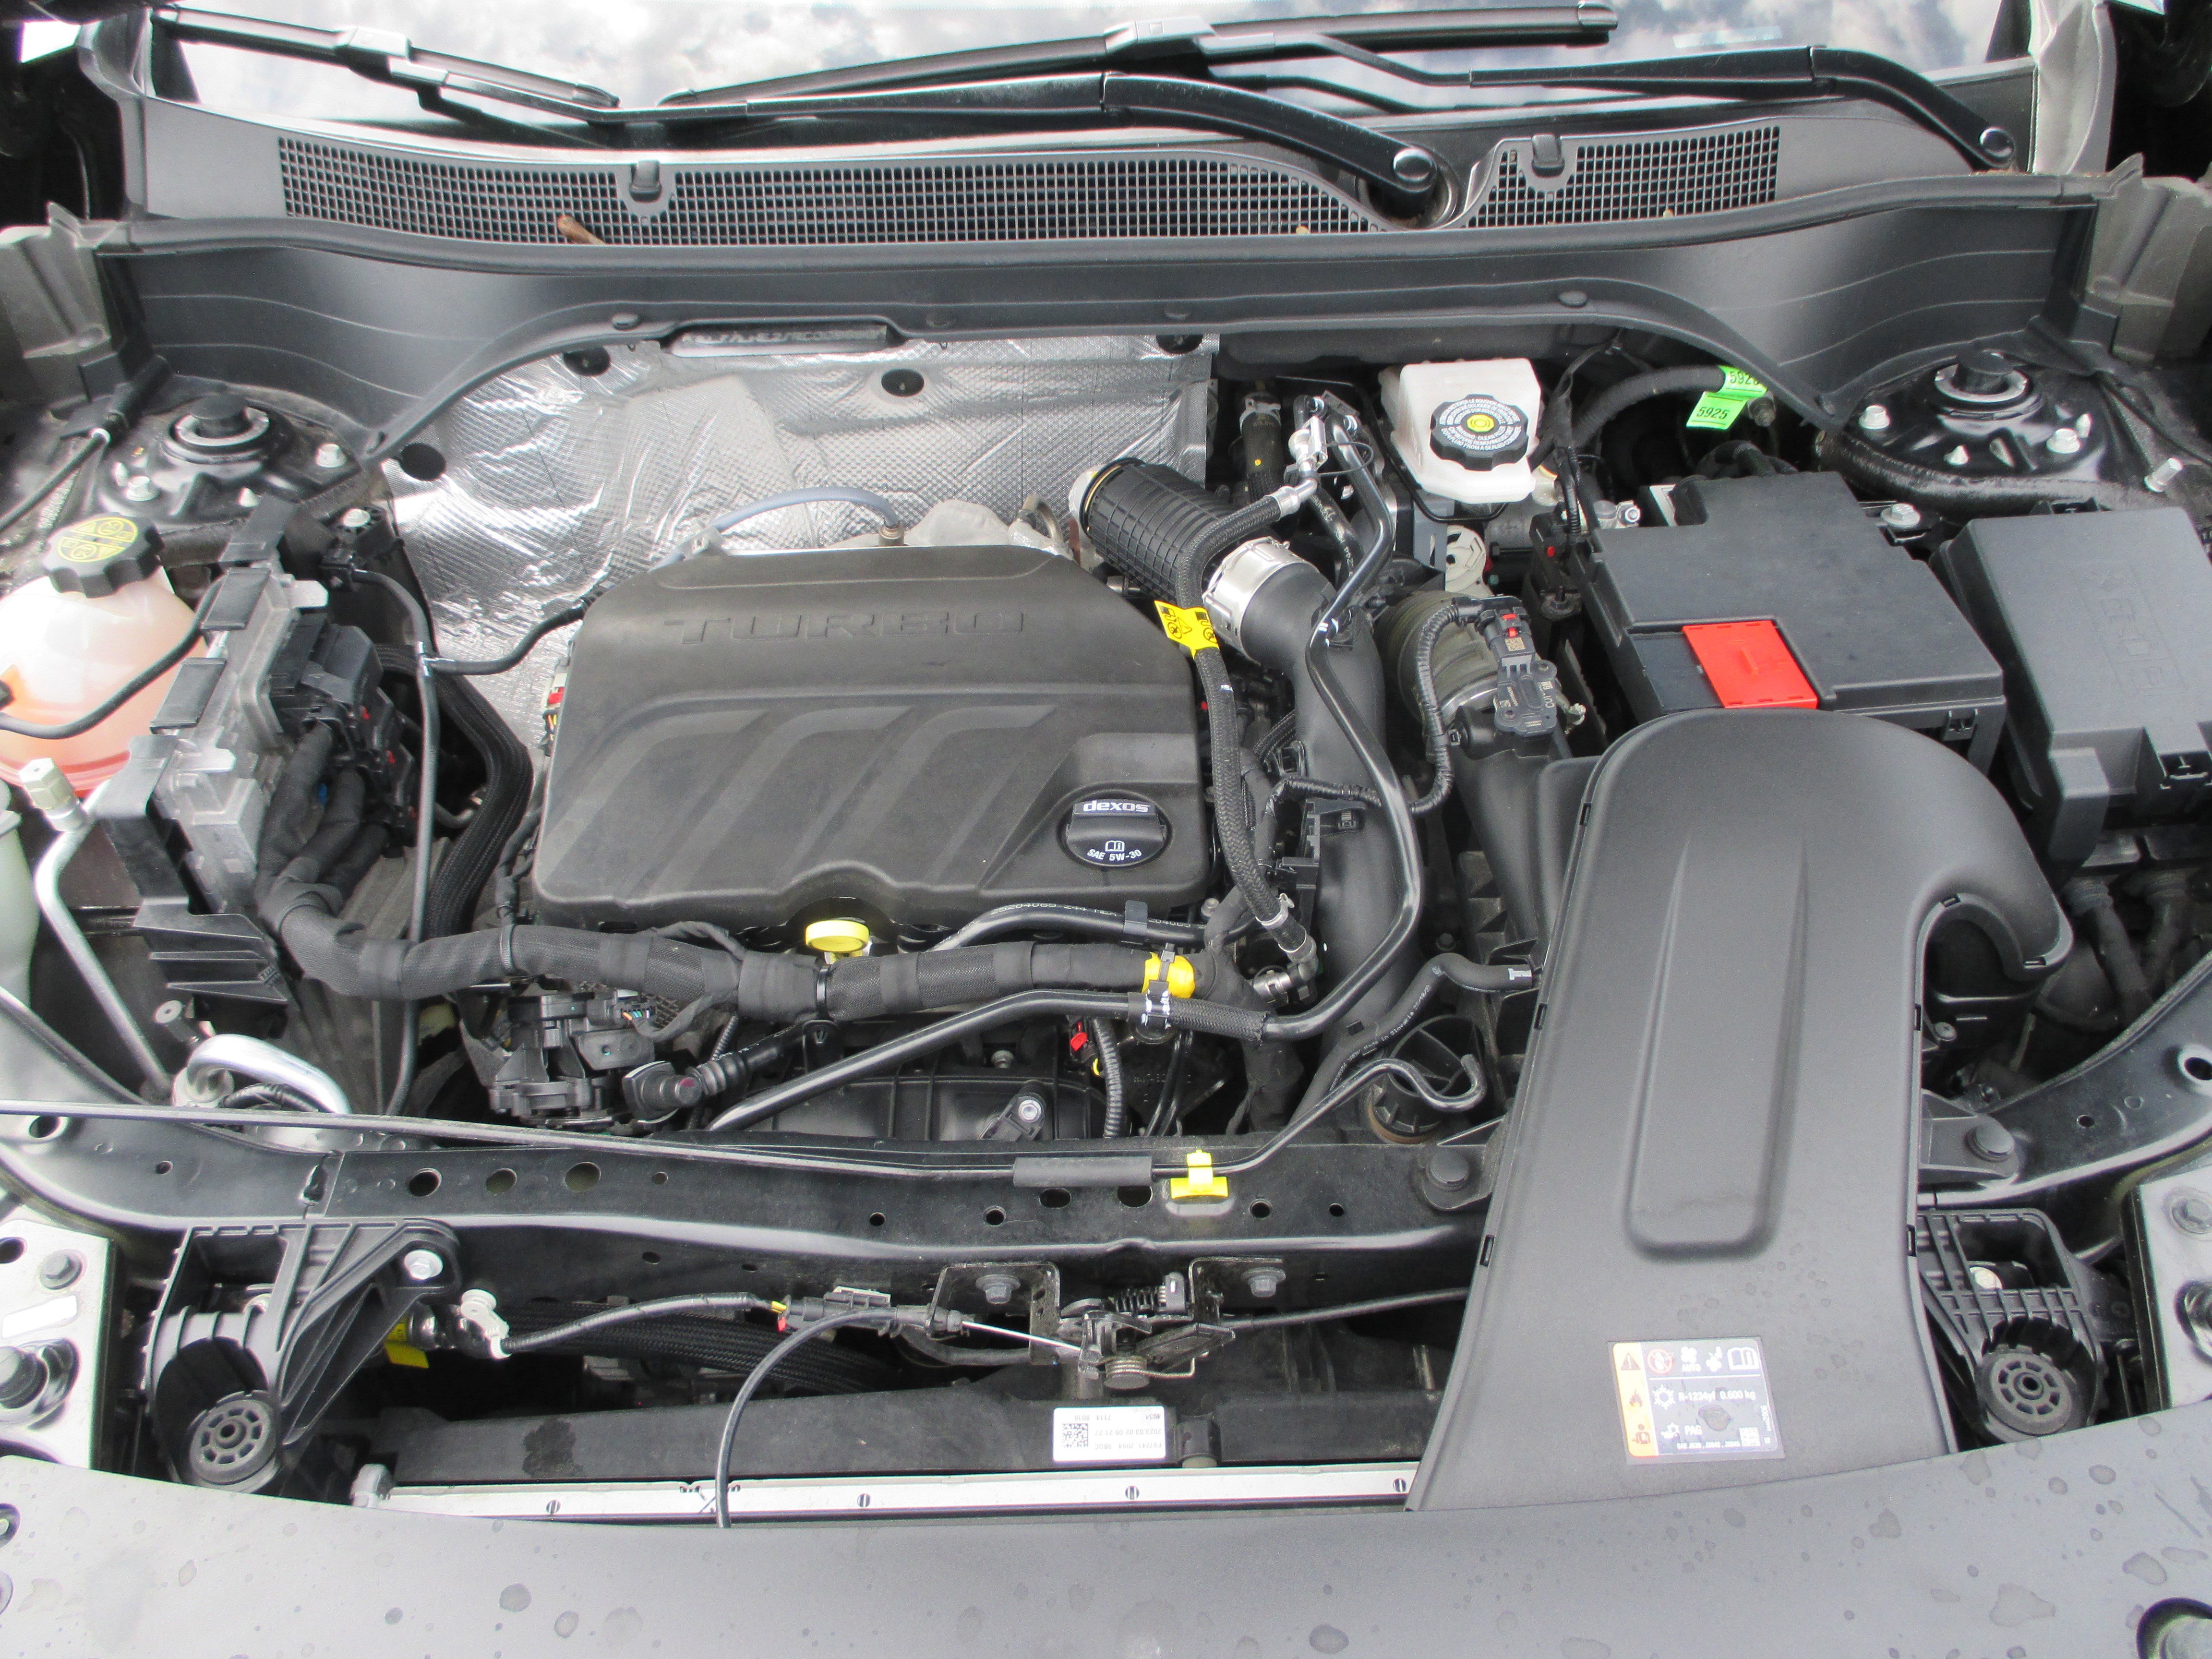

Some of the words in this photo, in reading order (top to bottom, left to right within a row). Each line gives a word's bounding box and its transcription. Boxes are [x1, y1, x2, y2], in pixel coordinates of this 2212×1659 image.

[1696, 407, 1729, 420] 5925
[664, 612, 1024, 644] TURBO
[1083, 800, 1149, 813] dexos
[1087, 849, 1106, 860] SAE
[1109, 849, 1142, 861] 5W-30
[1682, 1364, 1702, 1372] AUTO
[1719, 1390, 1743, 1400] 0.600
[1744, 1389, 1756, 1401] kg
[1684, 1425, 1703, 1436] PAG
